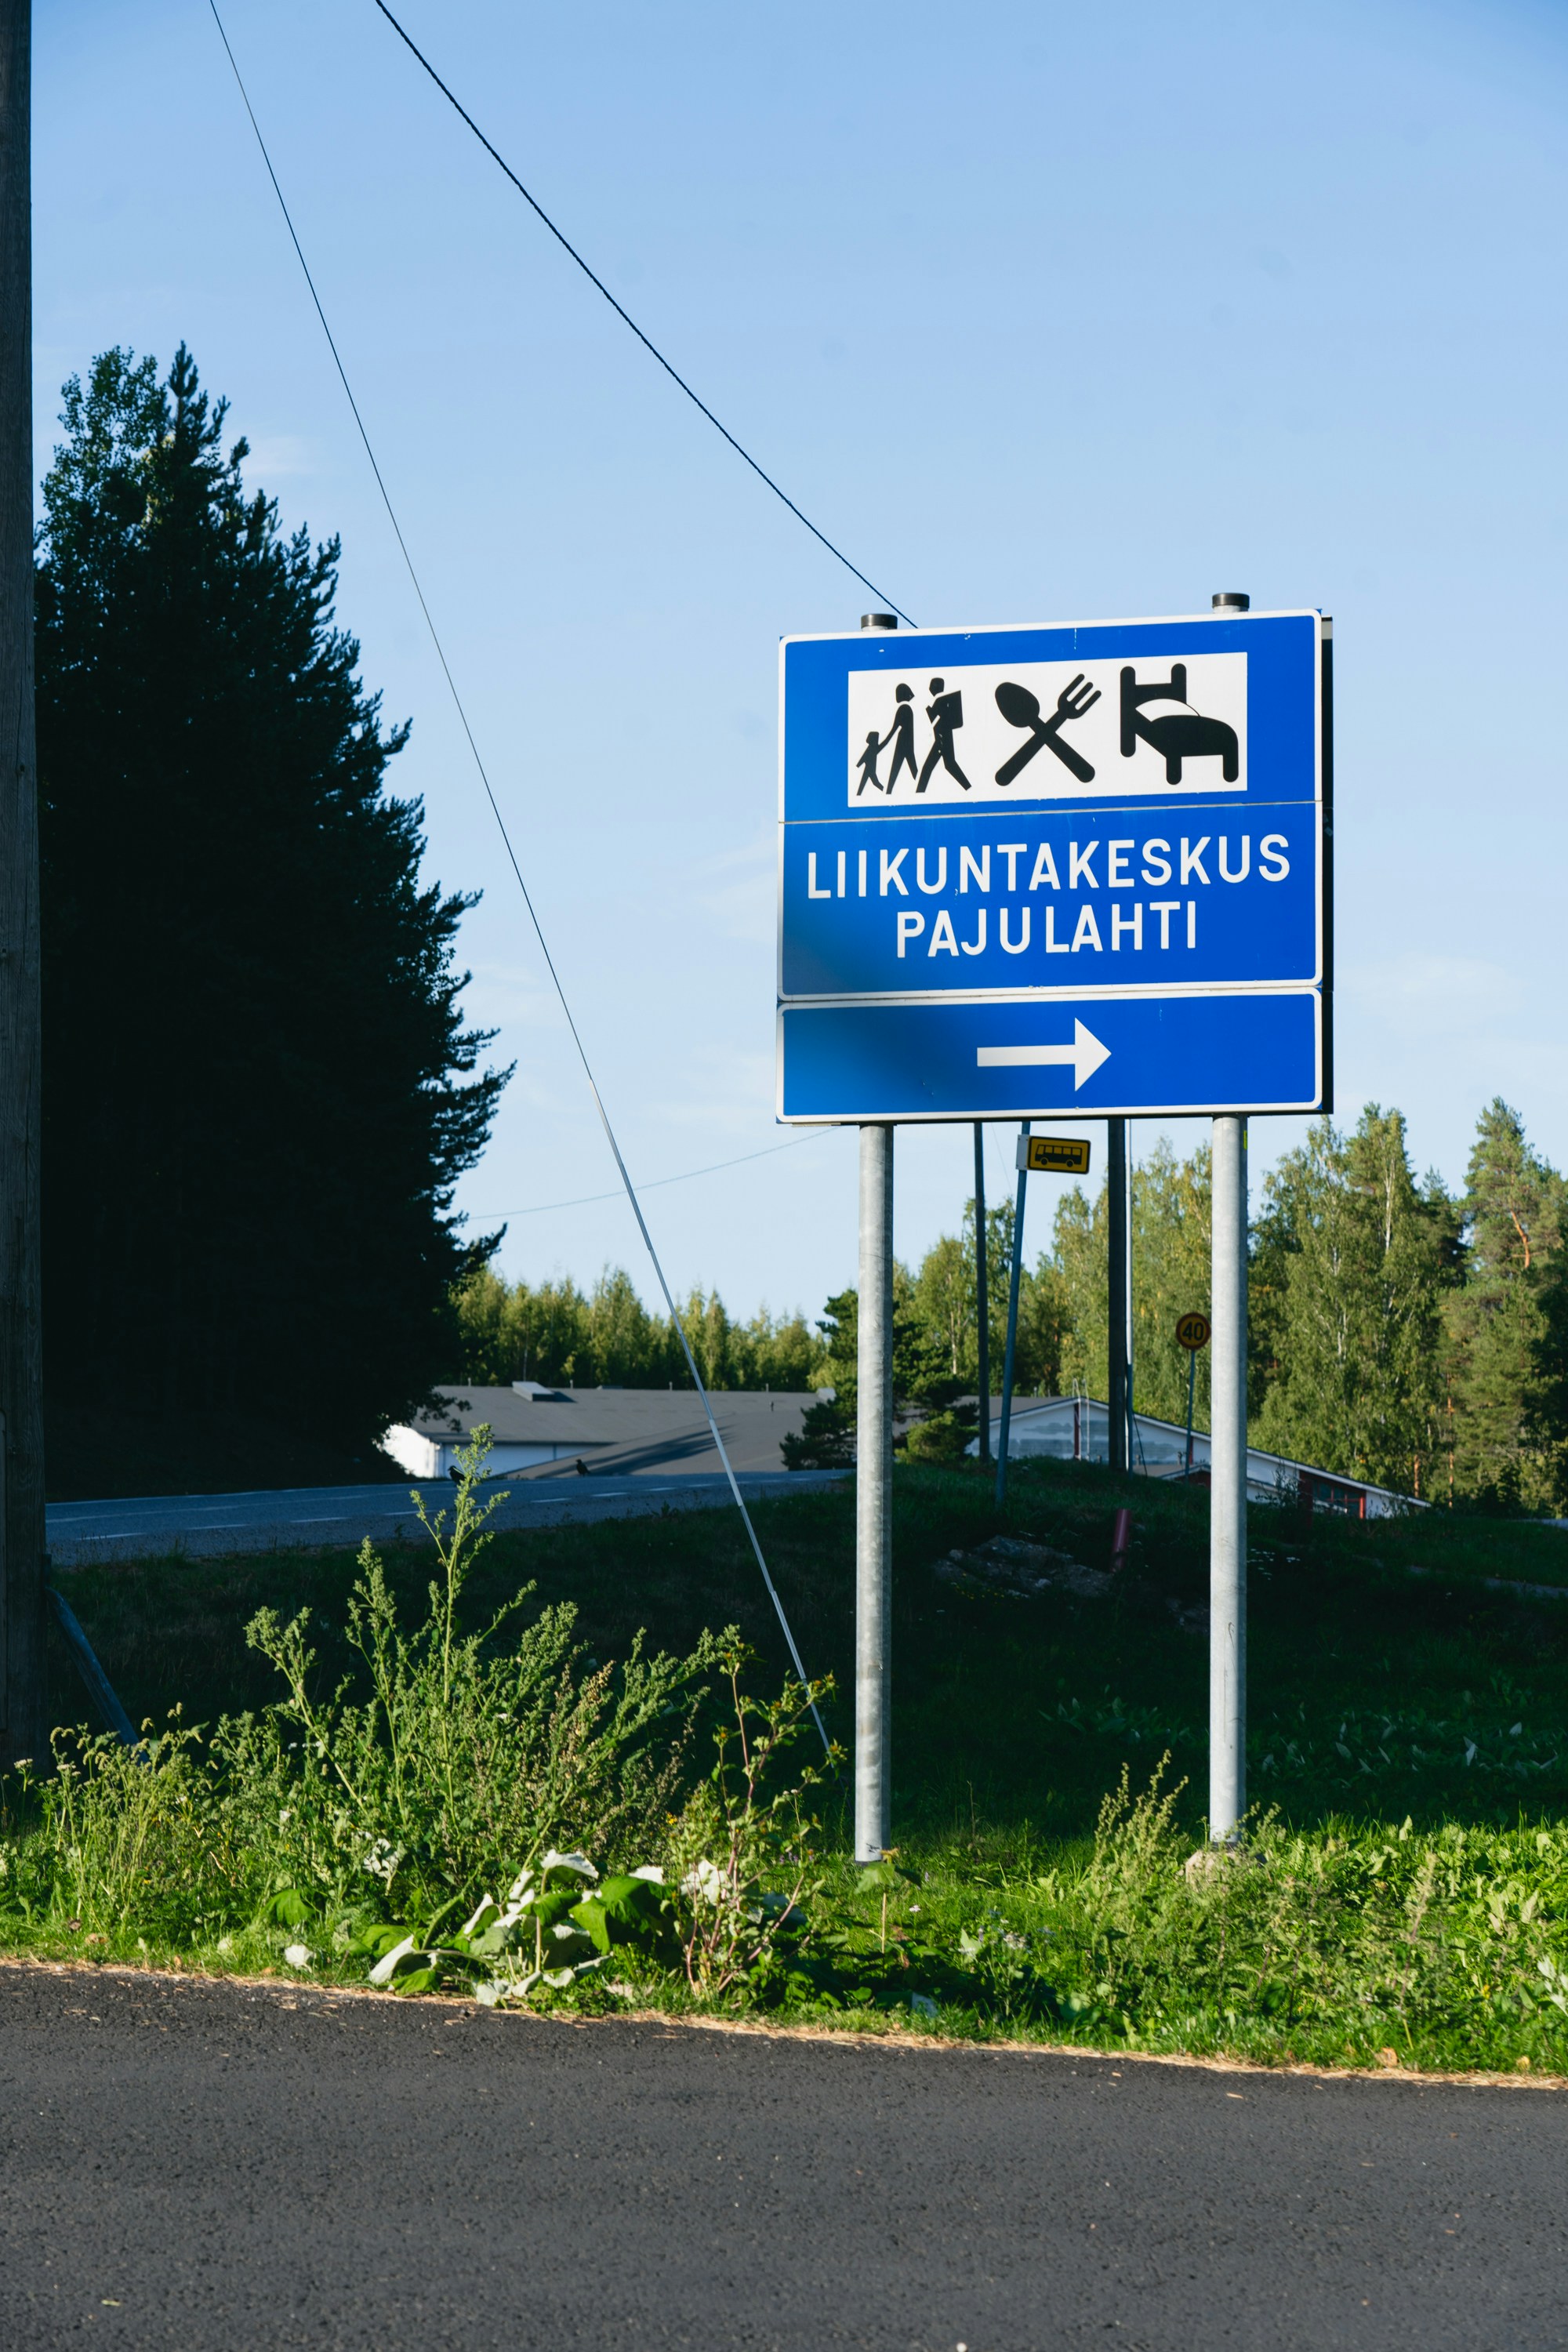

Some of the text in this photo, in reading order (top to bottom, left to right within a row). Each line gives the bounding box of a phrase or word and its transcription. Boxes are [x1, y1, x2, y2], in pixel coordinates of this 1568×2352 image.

[808, 833, 1290, 899] LIIKUNTAKESKUS
[897, 900, 1196, 958] PAJULAHTI
[1182, 1321, 1204, 1341] 40
